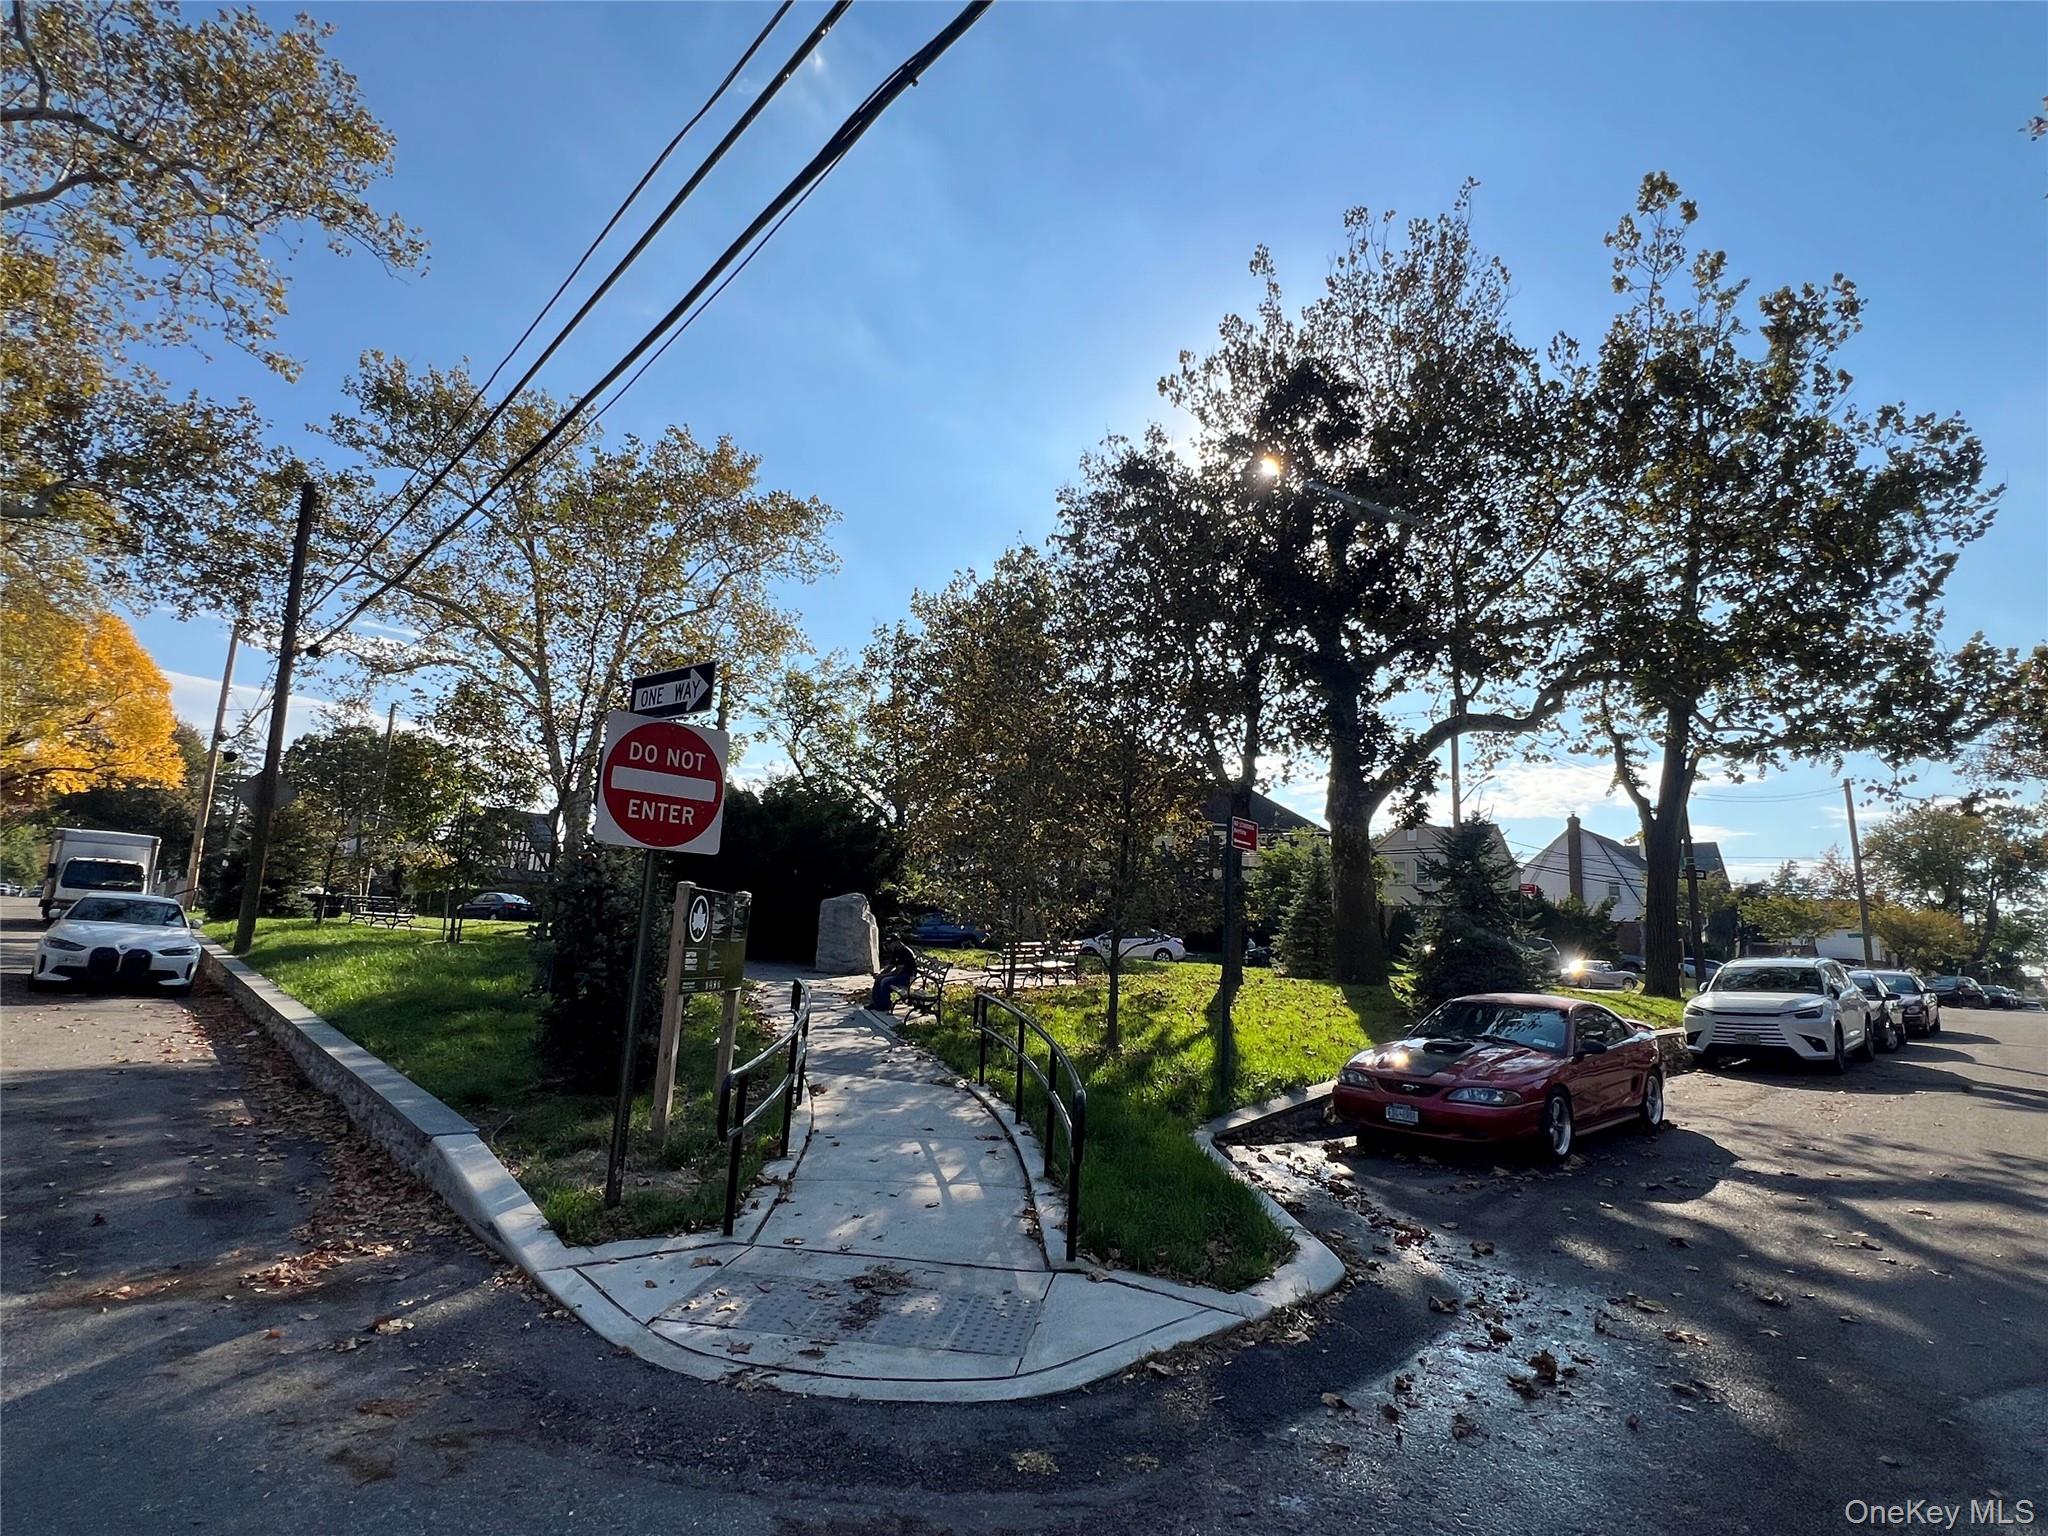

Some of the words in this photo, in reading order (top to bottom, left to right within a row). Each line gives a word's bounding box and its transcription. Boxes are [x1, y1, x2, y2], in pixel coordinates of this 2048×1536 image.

[640, 687, 664, 708] ONE
[675, 679, 701, 703] WAY
[629, 741, 658, 763] DO
[666, 748, 706, 771] NOT
[627, 799, 695, 825] ENTER
